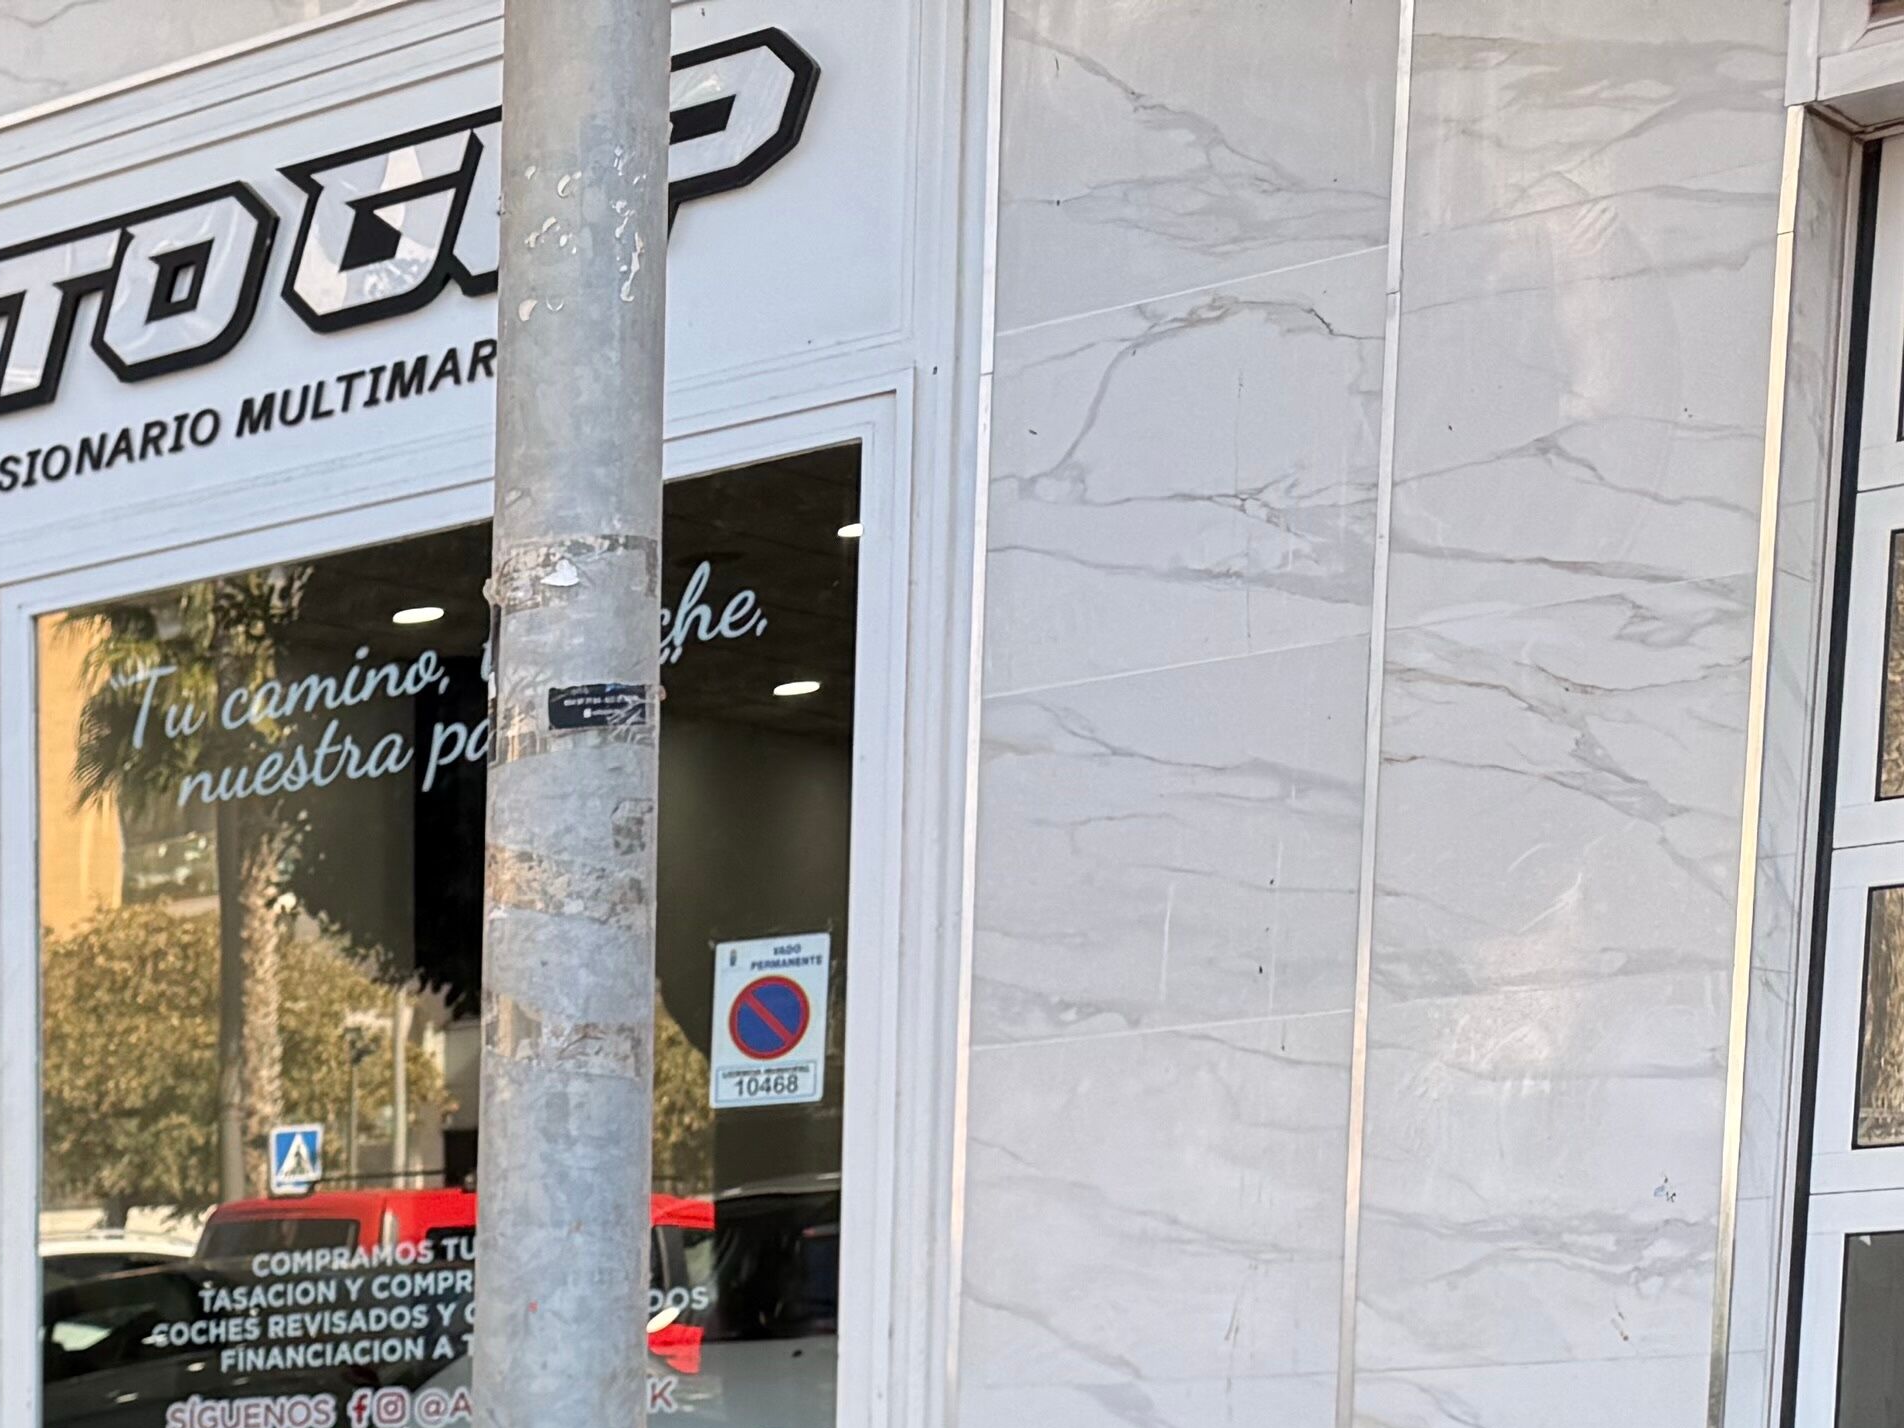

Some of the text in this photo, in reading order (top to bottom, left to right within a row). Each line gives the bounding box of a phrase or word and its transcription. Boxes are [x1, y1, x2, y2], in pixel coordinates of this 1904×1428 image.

[277, 27, 821, 334] GP
[235, 337, 499, 438] MULTIMAR
[177, 730, 416, 806] nuestra
[735, 1074, 799, 1097] 10468
[252, 1239, 435, 1278] COMPRAMOS
[198, 1269, 474, 1314] TASACION Y COMPR
[152, 1315, 261, 1348] COCHES
[267, 1304, 429, 1340] REVISADOS
[437, 1303, 458, 1326] Y
[220, 1335, 425, 1374] FINANCIACION
[432, 1336, 454, 1360] A
